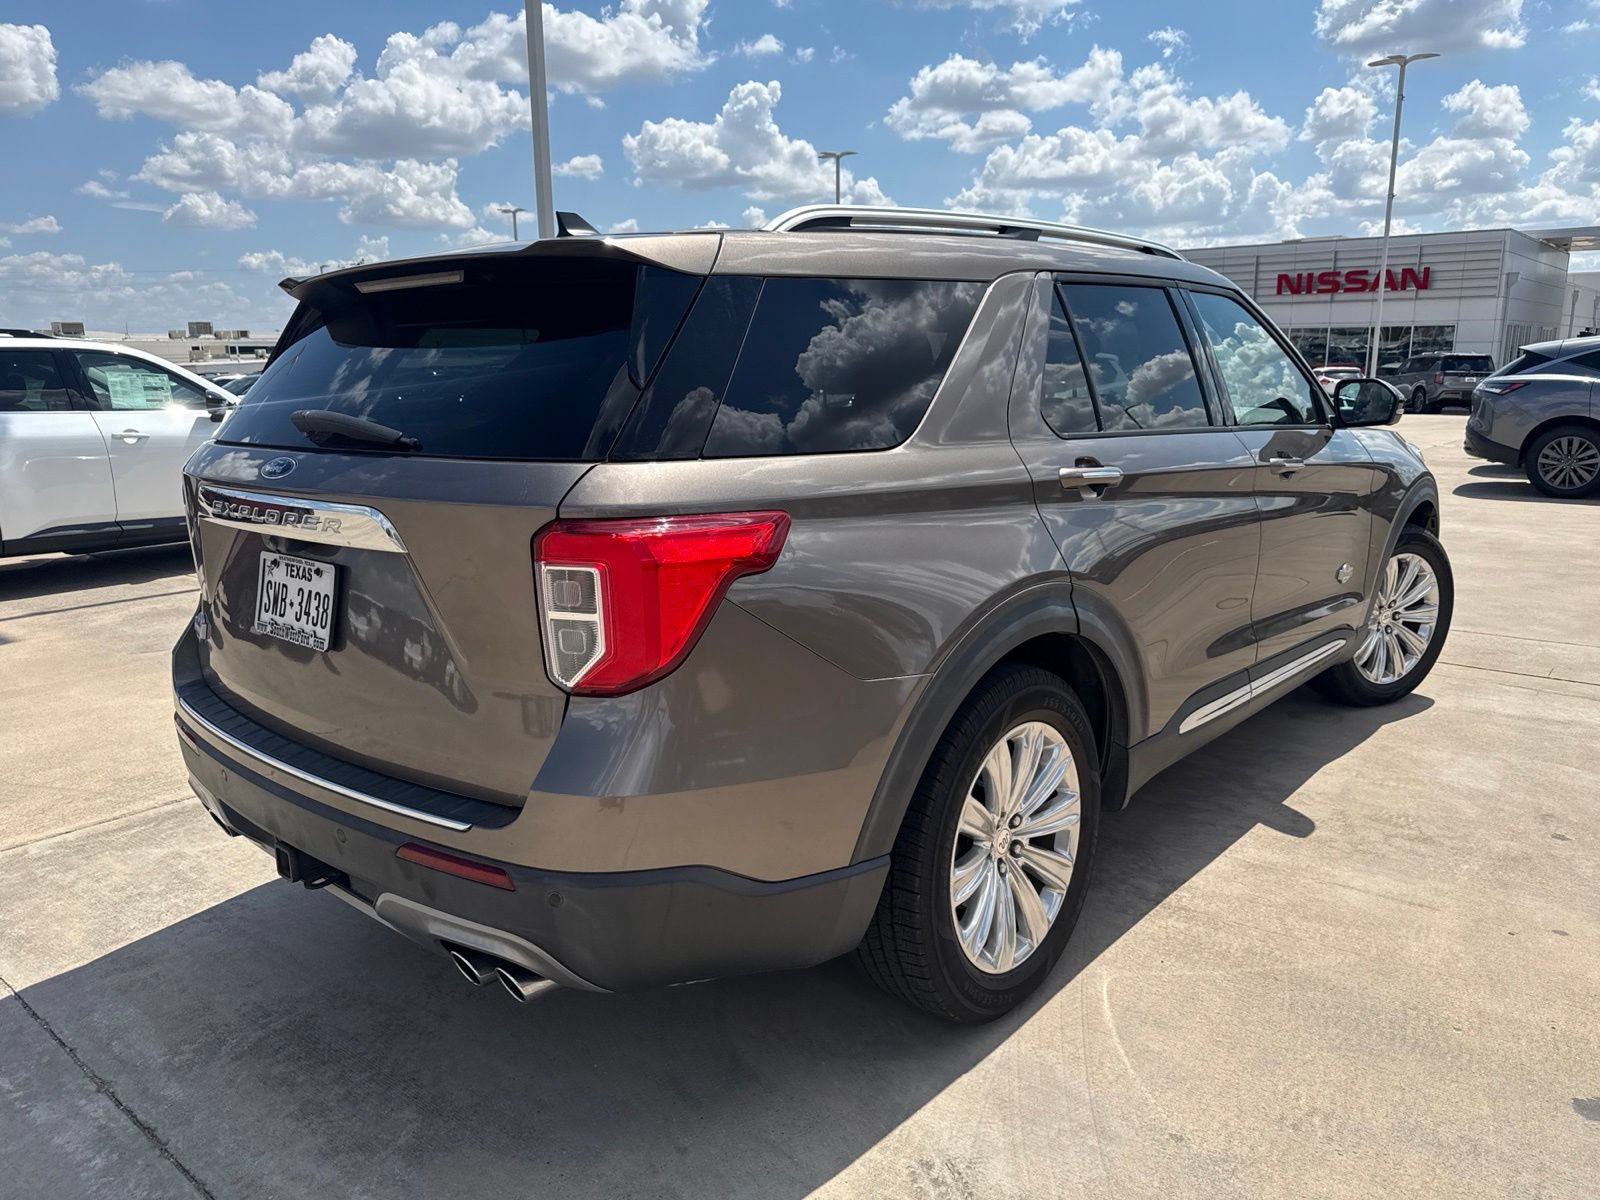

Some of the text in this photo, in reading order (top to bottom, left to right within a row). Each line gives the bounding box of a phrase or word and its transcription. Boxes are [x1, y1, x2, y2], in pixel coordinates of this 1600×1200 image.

[1276, 266, 1431, 295] NISSAN
[212, 500, 342, 534] EXPLORER
[285, 562, 313, 582] TEXAS
[295, 587, 330, 630] 3438
